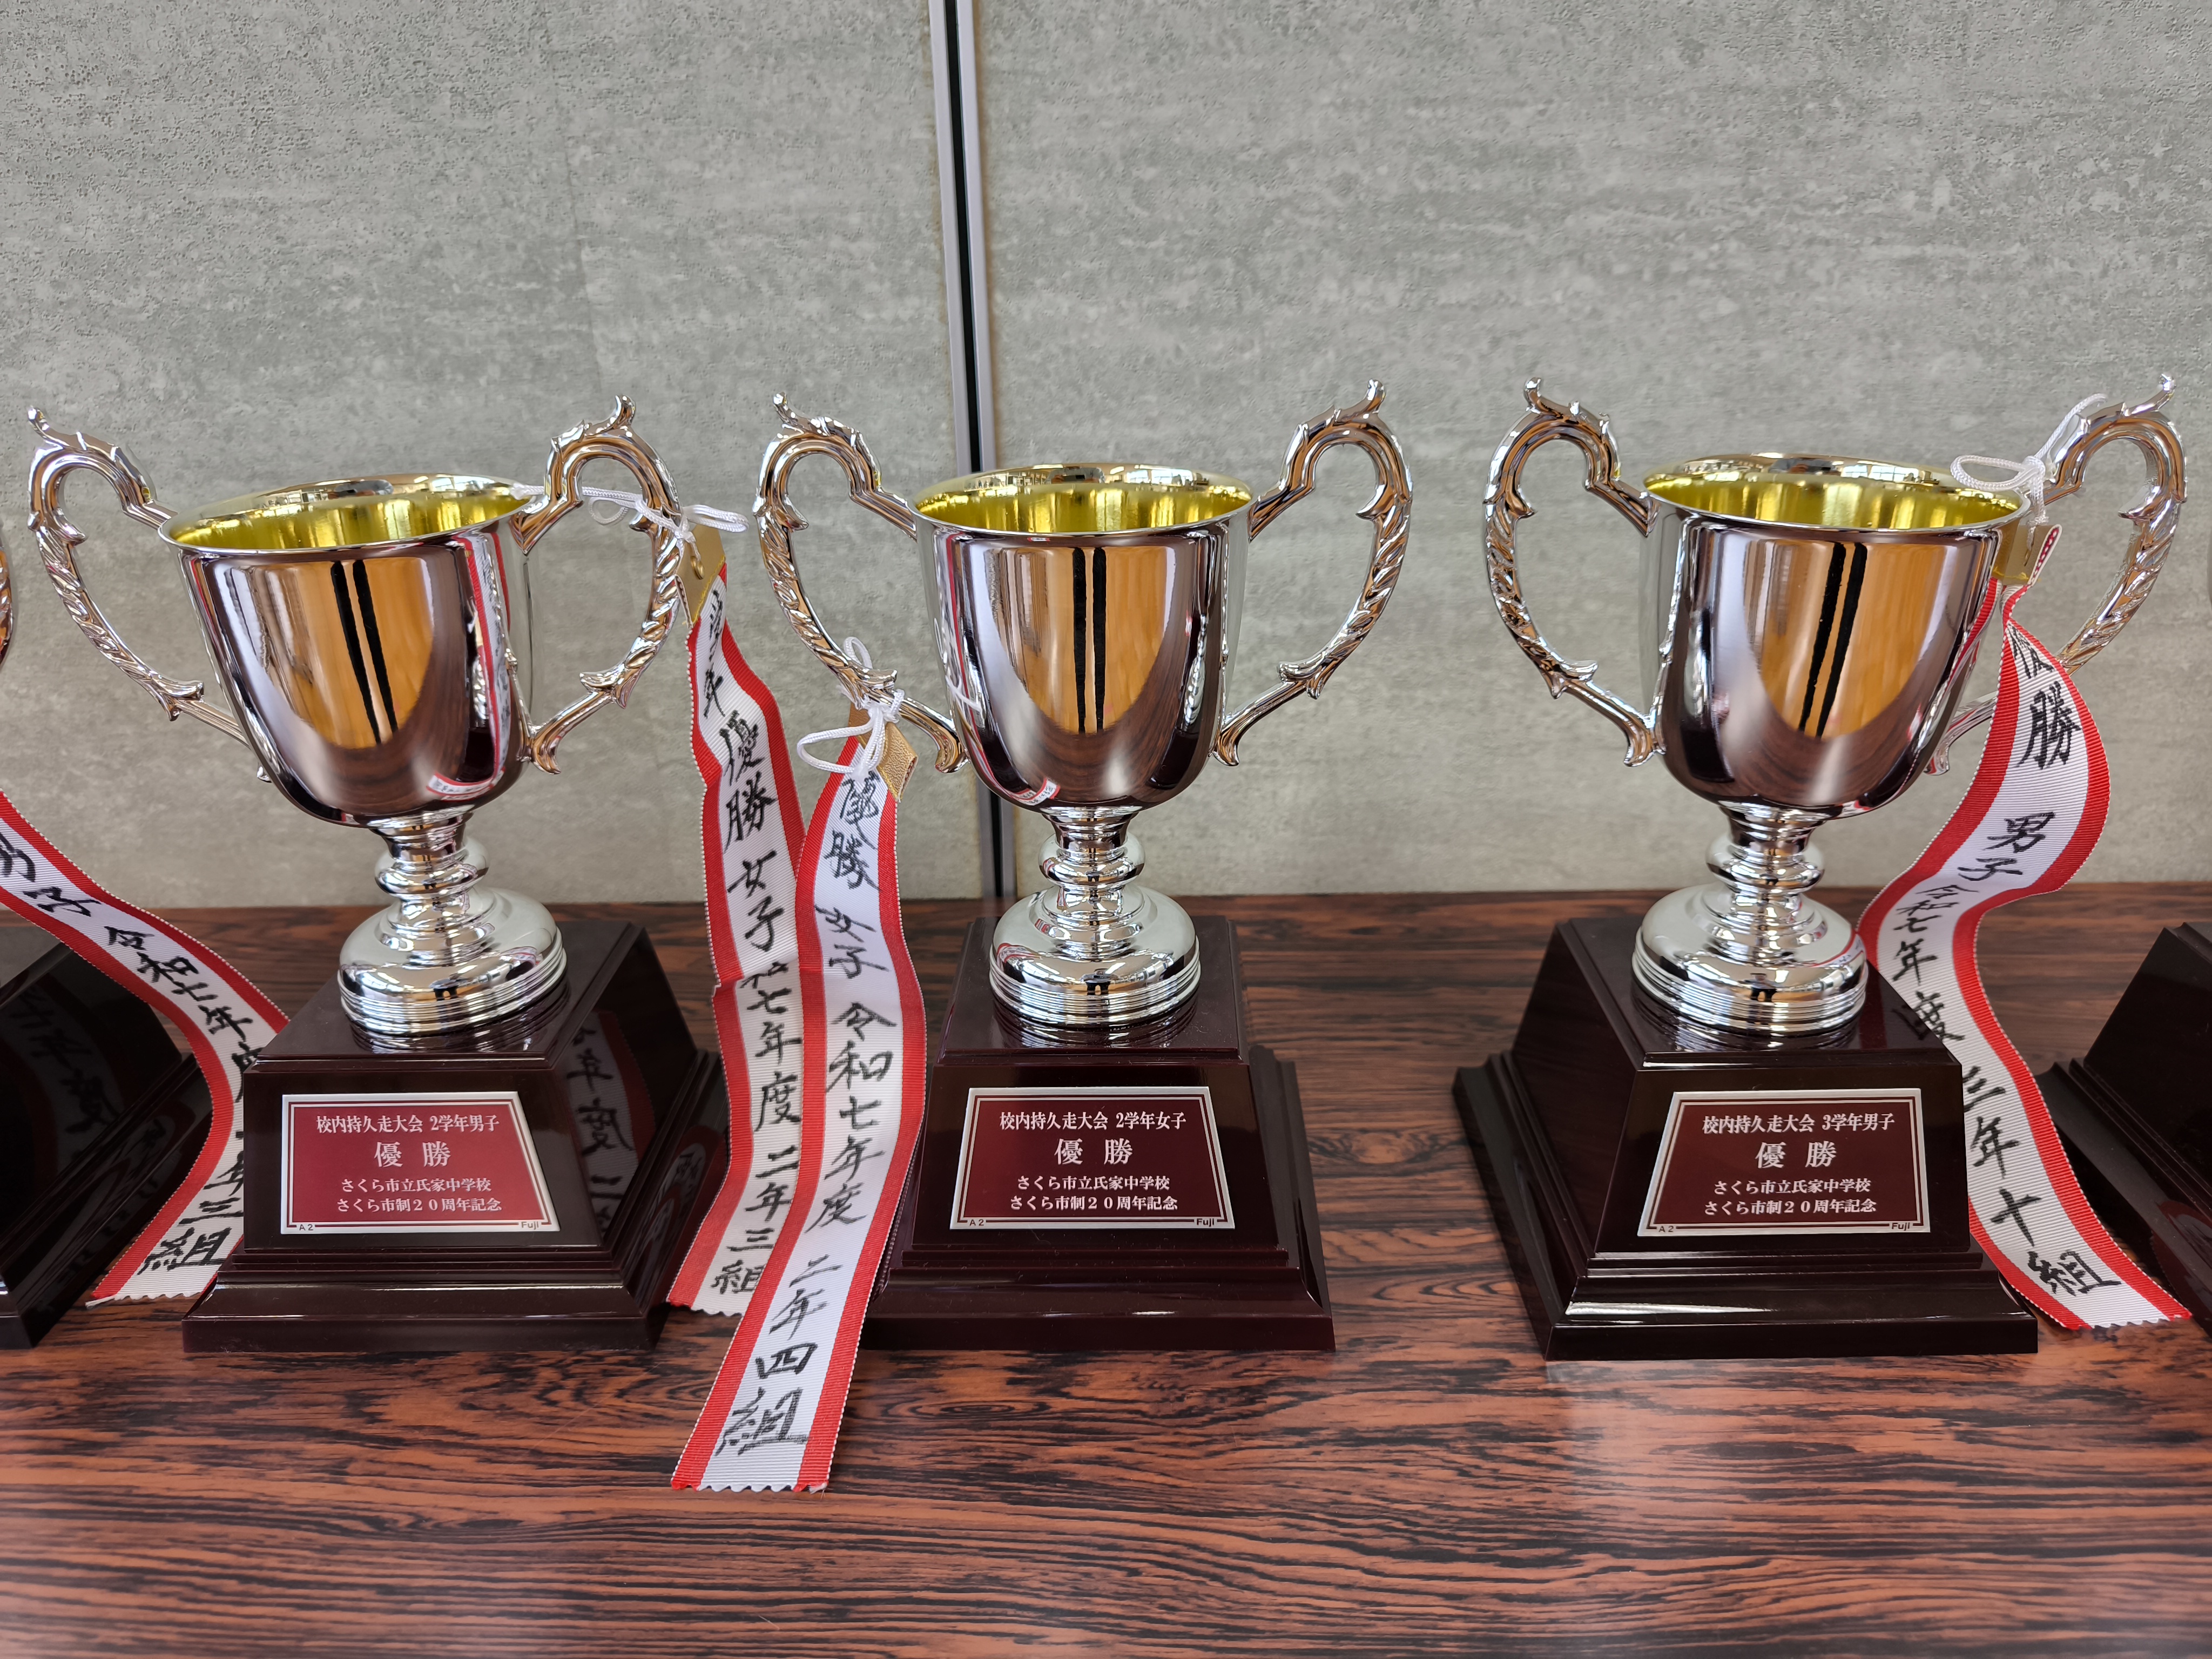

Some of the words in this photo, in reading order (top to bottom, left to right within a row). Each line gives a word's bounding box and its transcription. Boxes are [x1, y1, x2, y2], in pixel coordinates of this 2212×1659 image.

[1958, 811, 2056, 881] 男子
[814, 903, 888, 979] 女子
[316, 1116, 423, 1134] 校内持久走大会
[430, 1115, 499, 1132] 2学年男子
[804, 1002, 897, 1233] 令和七年度
[1000, 1112, 1108, 1130] 校内持久走大会
[1116, 1112, 1186, 1130] 2学年女子
[1703, 1114, 1815, 1134] 校内持久走大会
[1822, 1113, 1894, 1131] 3学年男子
[374, 1141, 451, 1168] 優勝
[1055, 1138, 1133, 1165] 優勝
[1755, 1142, 1837, 1168] 優勝
[341, 1178, 491, 1192] さくら市立氏家中学校
[1017, 1176, 1170, 1190] さくら市立氏家中学校
[1714, 1178, 1871, 1195] さくら市立氏家中学校
[1963, 1065, 2121, 1296] 三年十組
[337, 1198, 502, 1212] さくら市制20周年記念
[1010, 1196, 1178, 1210] さくら市制20周年記念
[1705, 1199, 1877, 1216] さくら市制20周年記念
[521, 1221, 539, 1229] Fuji
[1196, 1218, 1215, 1227] Fuji
[1892, 1222, 1910, 1230] Fuji
[716, 1253, 842, 1455] 二年四組
